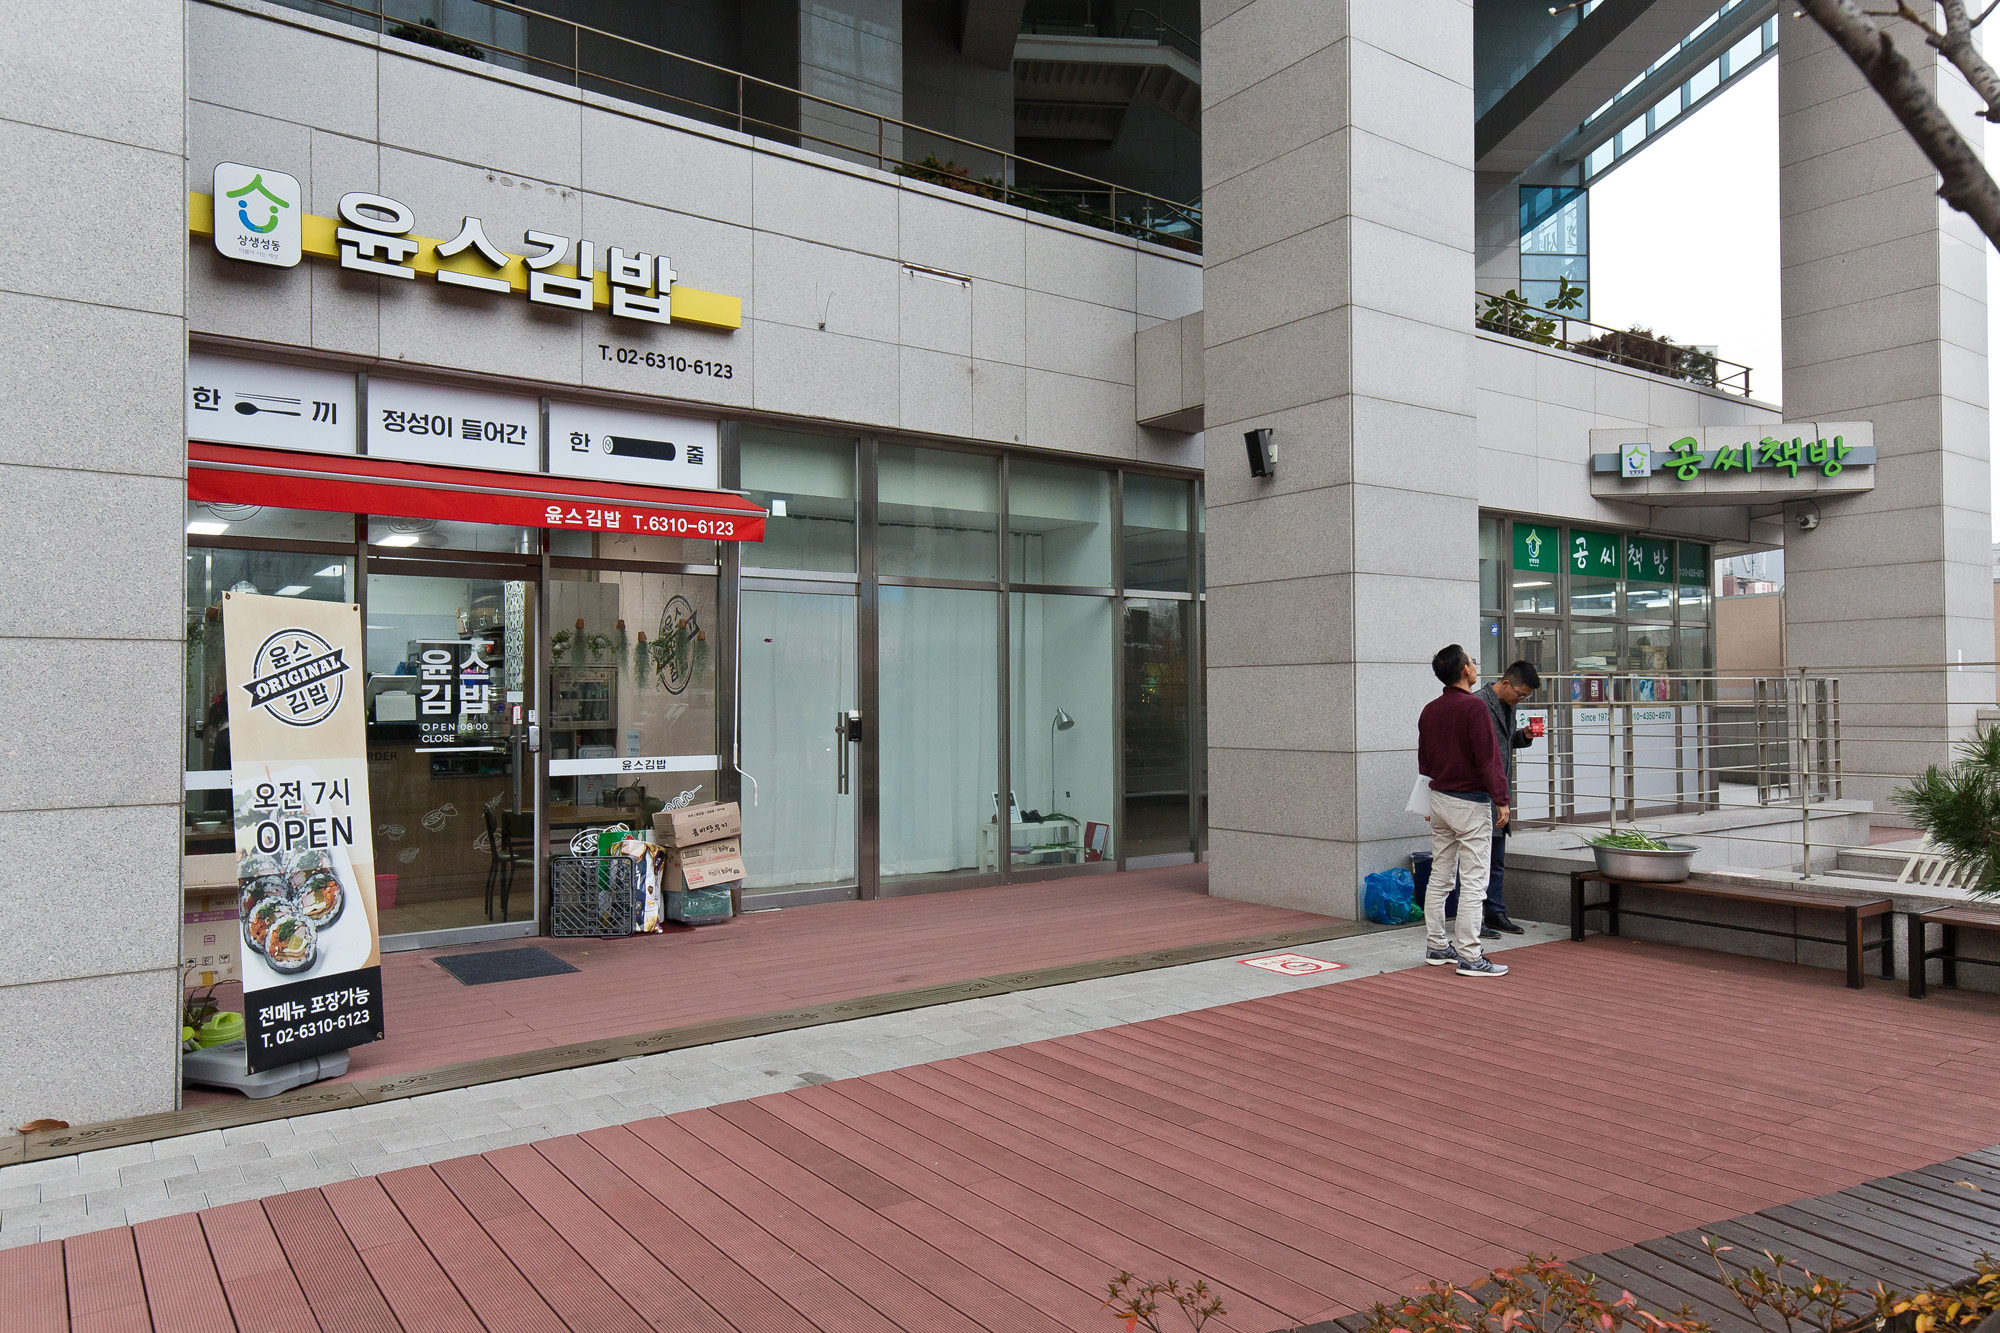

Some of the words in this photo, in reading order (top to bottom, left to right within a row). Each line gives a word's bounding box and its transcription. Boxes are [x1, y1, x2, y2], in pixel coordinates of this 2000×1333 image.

[236, 234, 281, 252] 상생성동
[335, 190, 679, 325] 윤스김밥
[598, 344, 613, 362] T.
[616, 347, 733, 380] 02-6310-6123
[192, 386, 222, 412] 한
[312, 400, 337, 425] 끼
[382, 409, 453, 438] 정성이
[461, 418, 528, 446] 들어간
[569, 431, 591, 453] 한
[686, 444, 704, 466] 줄
[1662, 434, 1854, 481] 공씨책방
[544, 505, 621, 529] 윤스김밥
[632, 514, 734, 536] T.6310-6123
[269, 640, 312, 670] 윤스
[420, 649, 490, 680] 윤스
[255, 655, 341, 698] ORIGINAL
[286, 682, 329, 715] 김밥
[420, 684, 494, 714] 김밥
[421, 723, 456, 731] OPEN
[460, 722, 489, 731] 08:00
[1580, 712, 1596, 722] Since
[1633, 711, 1672, 721] 10-4350-4970
[421, 734, 455, 743] CLOSE
[367, 751, 398, 761] RDER
[622, 759, 667, 771] 윤스김밥
[253, 780, 302, 810] 오전
[311, 778, 350, 806] 7시
[256, 816, 353, 853] OPEN
[259, 1001, 307, 1027] 전메뉴
[310, 986, 370, 1014] 포장가능
[260, 1033, 274, 1048] T.
[276, 1009, 370, 1045] 02-6310-6123
